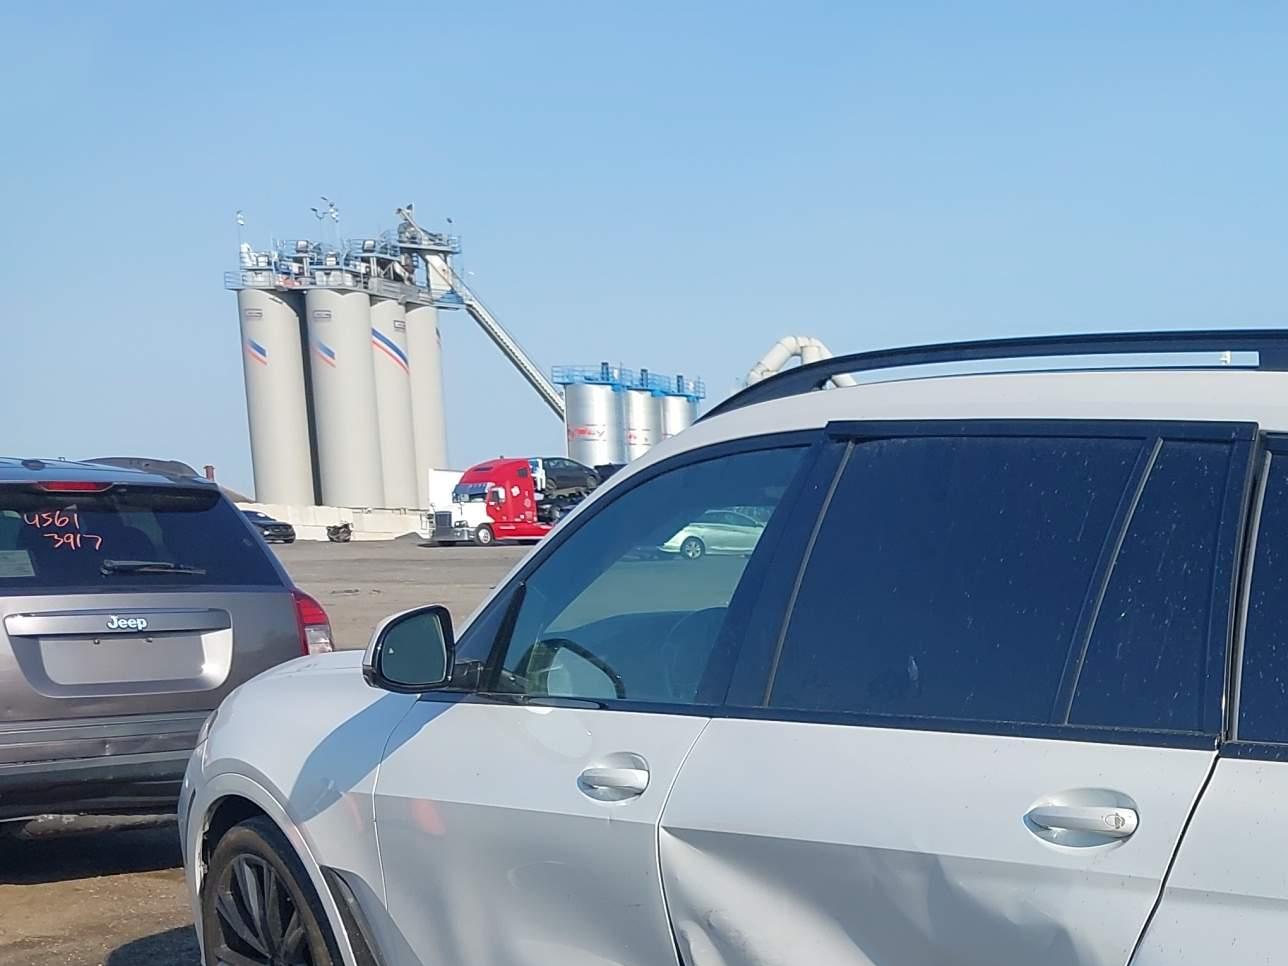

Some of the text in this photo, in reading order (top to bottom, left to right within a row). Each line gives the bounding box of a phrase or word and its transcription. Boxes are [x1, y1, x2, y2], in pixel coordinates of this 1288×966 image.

[24, 511, 80, 529] 4561
[43, 533, 102, 551] 3917
[107, 615, 147, 630] Jeep
